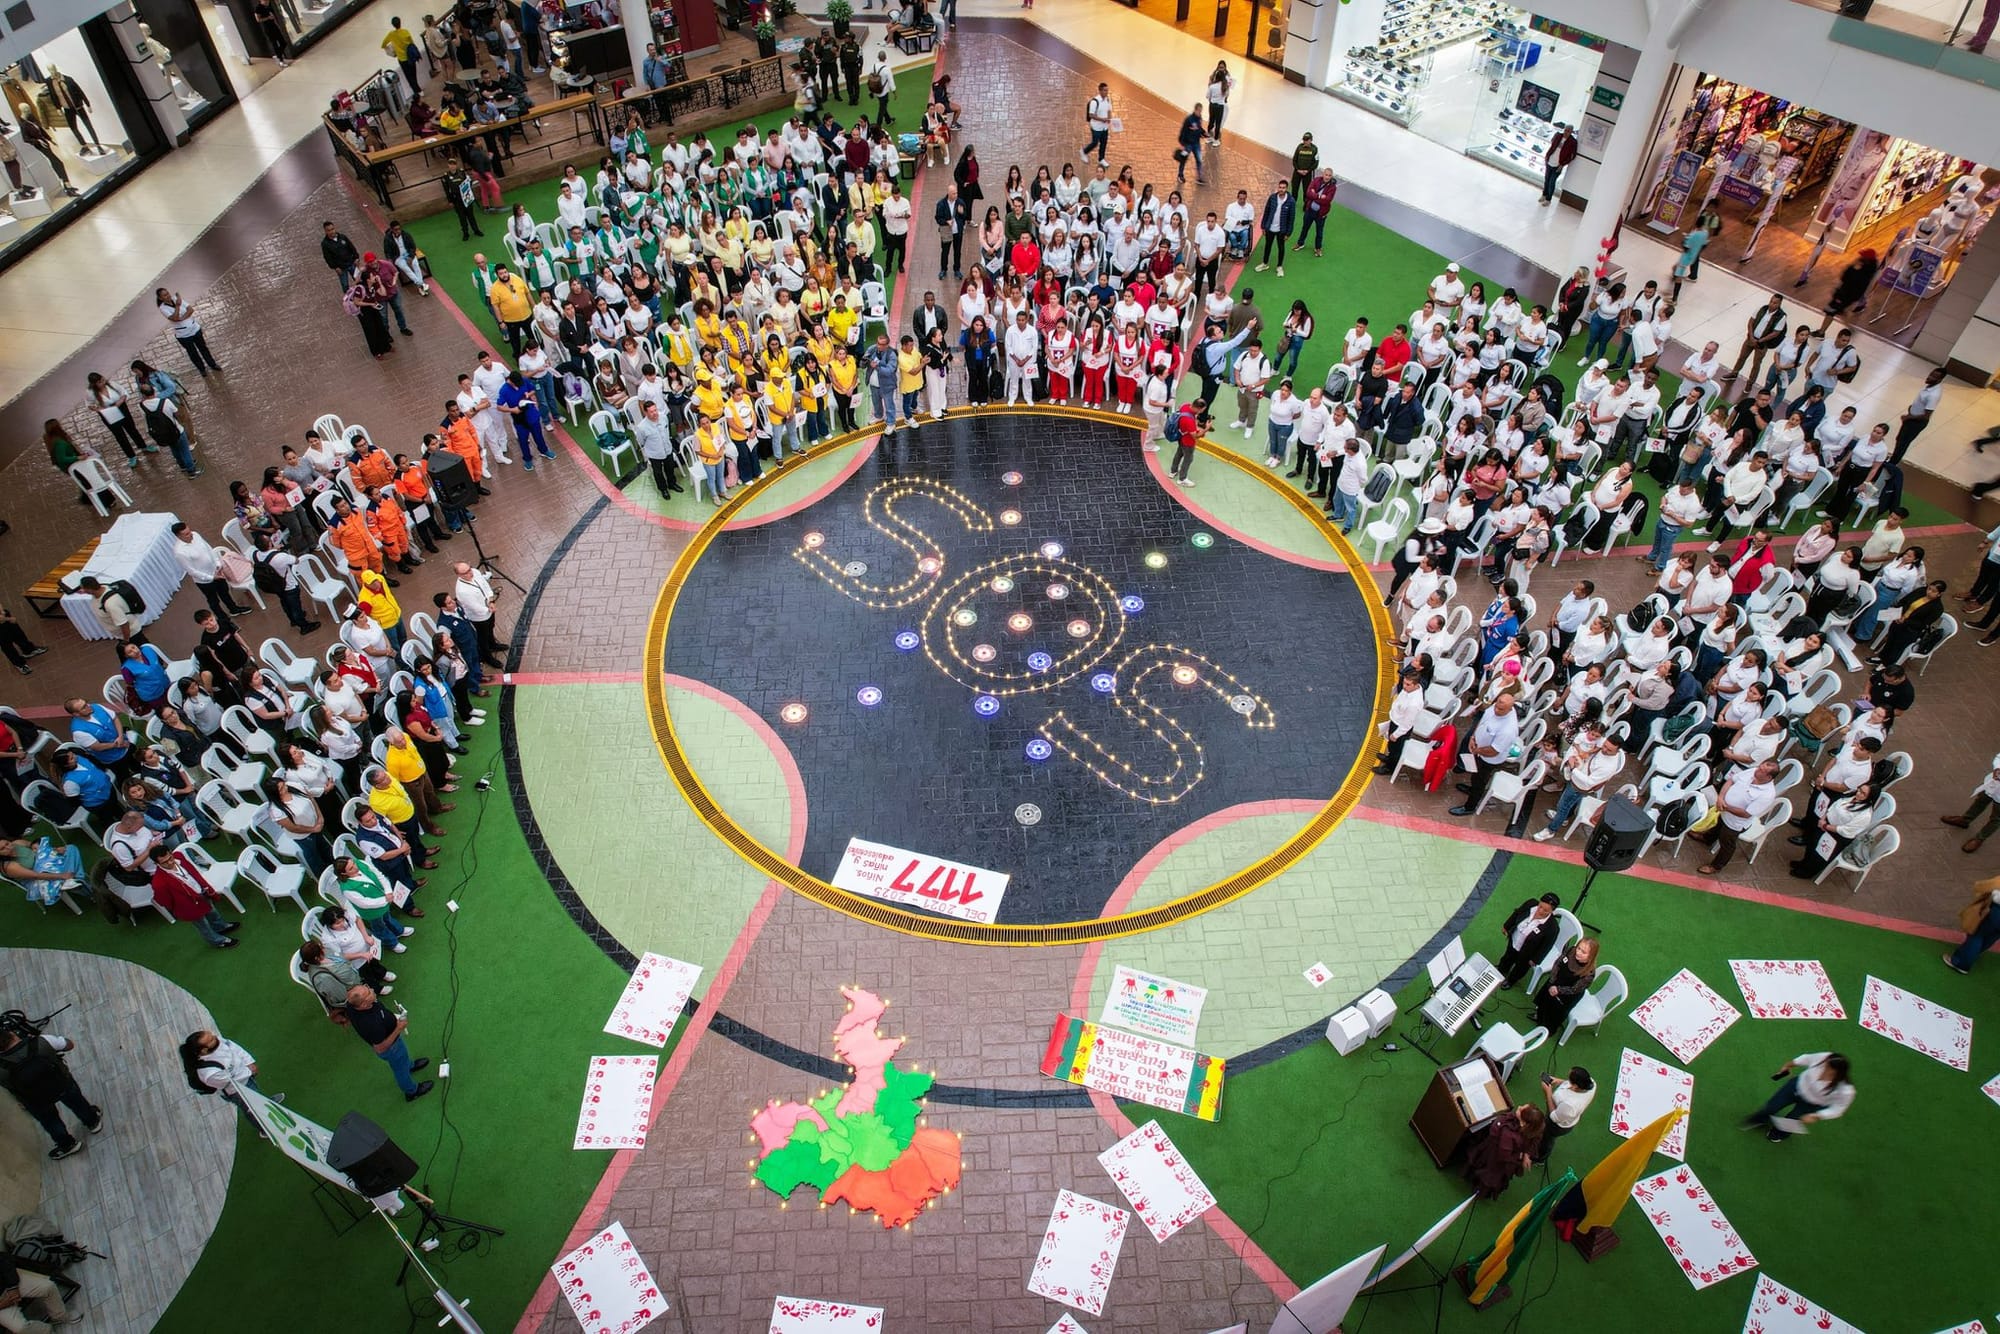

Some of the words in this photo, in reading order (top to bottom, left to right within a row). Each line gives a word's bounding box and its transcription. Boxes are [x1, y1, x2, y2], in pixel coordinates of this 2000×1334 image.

[853, 855, 862, 865] y
[862, 858, 889, 871] niñas
[889, 859, 984, 905] 1177
[873, 886, 907, 902] 2025
[922, 898, 958, 916] 2021
[964, 906, 988, 922] DEL
[1140, 1041, 1161, 1053] LA
[1165, 1046, 1177, 1056] A
[1095, 1054, 1113, 1070] LA
[1119, 1060, 1129, 1072] A
[1134, 1079, 1186, 1099] ROJAS
[1153, 1096, 1183, 1113] LAS
